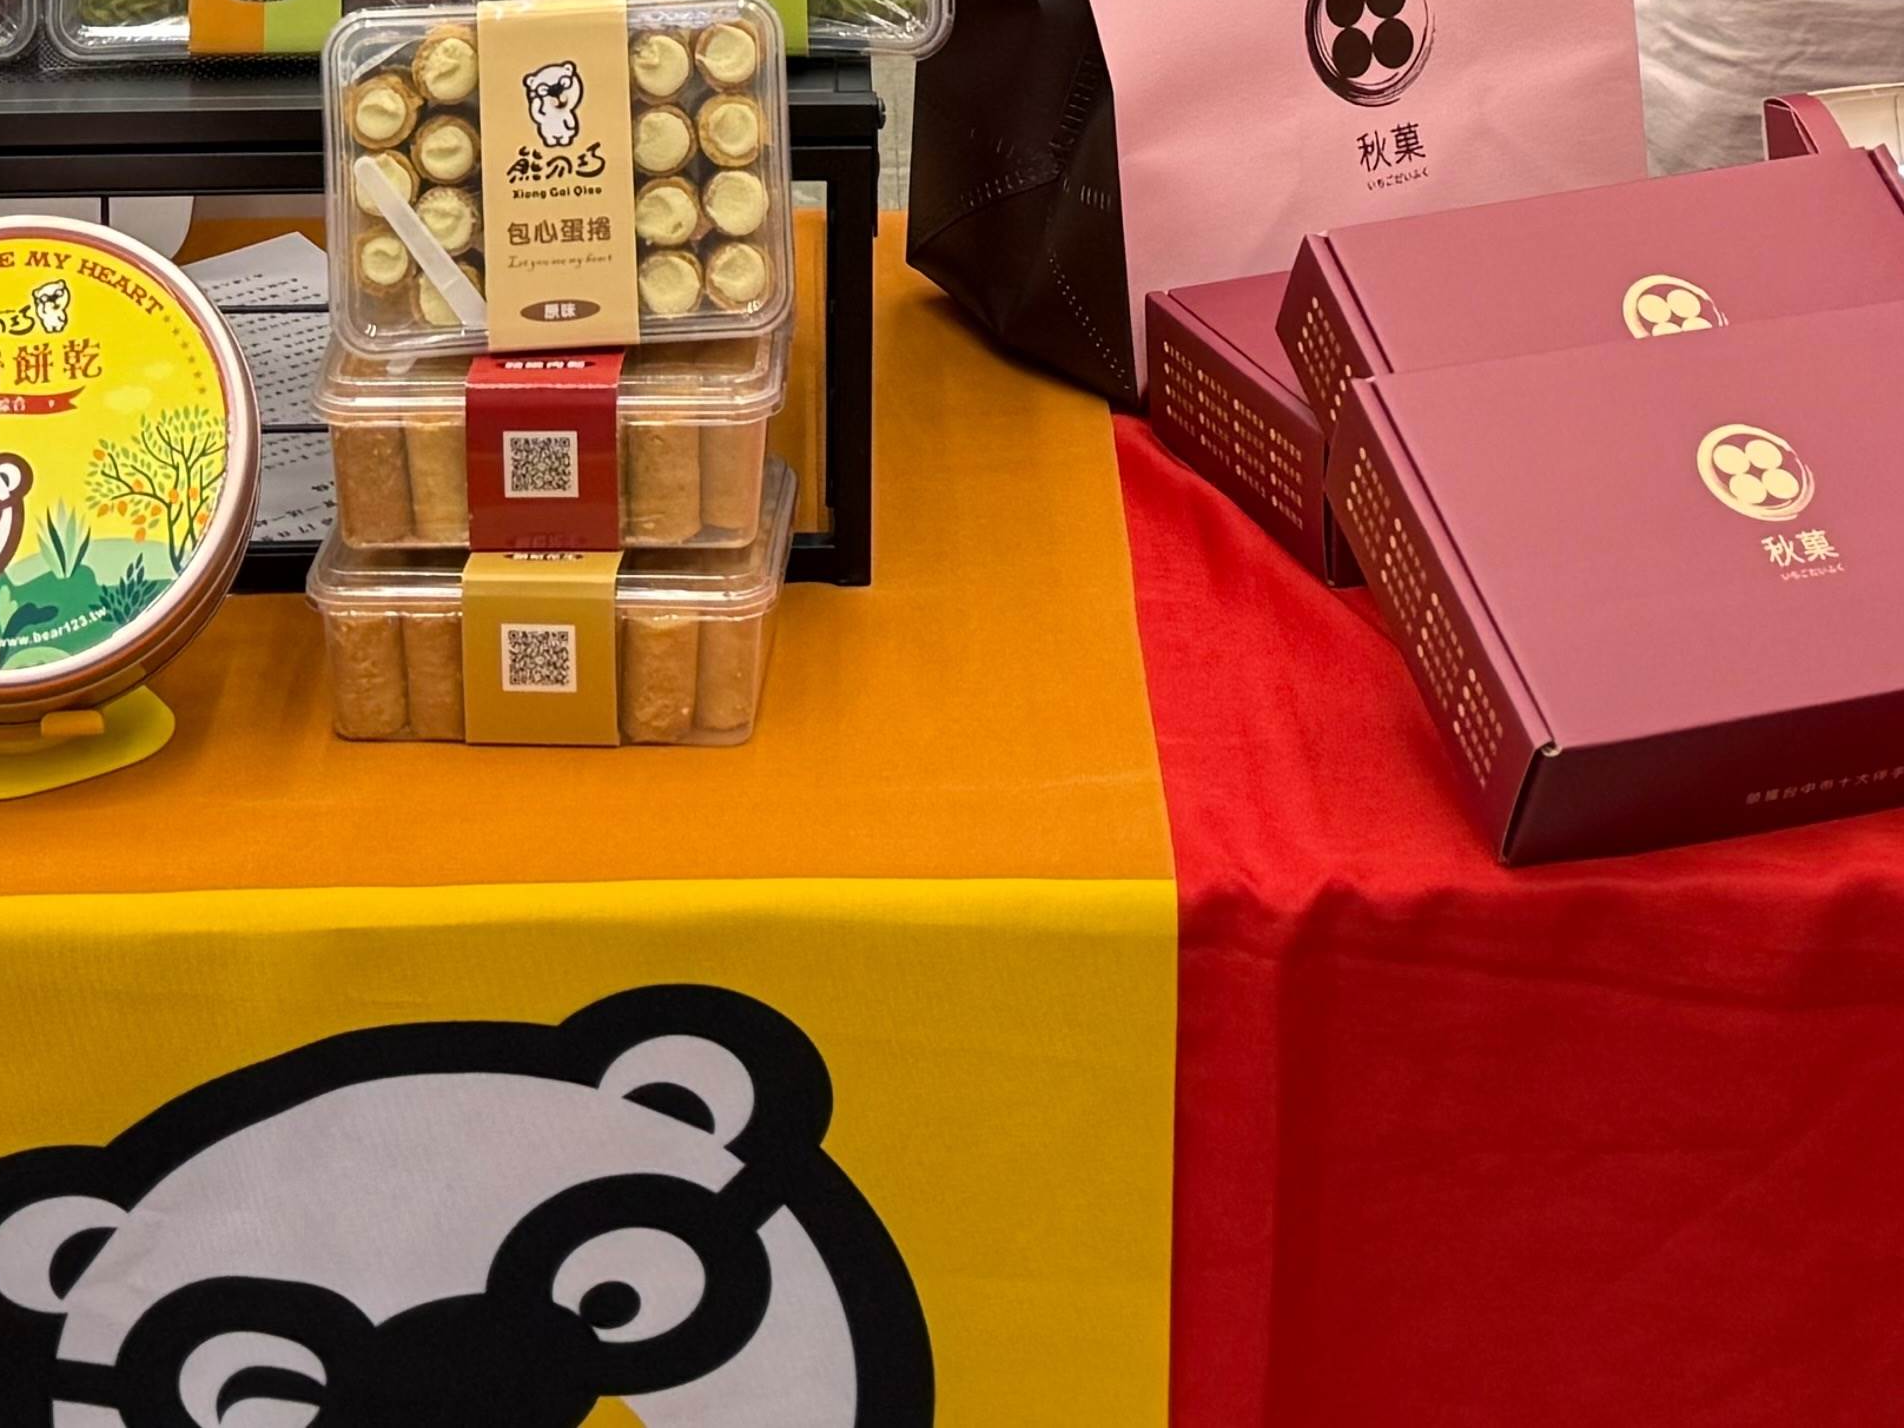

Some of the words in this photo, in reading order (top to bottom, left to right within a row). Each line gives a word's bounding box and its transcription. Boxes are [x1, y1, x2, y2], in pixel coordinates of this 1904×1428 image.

[1356, 121, 1426, 172] 秋菓
[507, 216, 611, 246] 包心蛋捲
[24, 250, 73, 270] MY
[77, 258, 165, 315] HEART
[1761, 529, 1840, 567] 秋菓
[0, 606, 107, 647] www.bear123.tw
